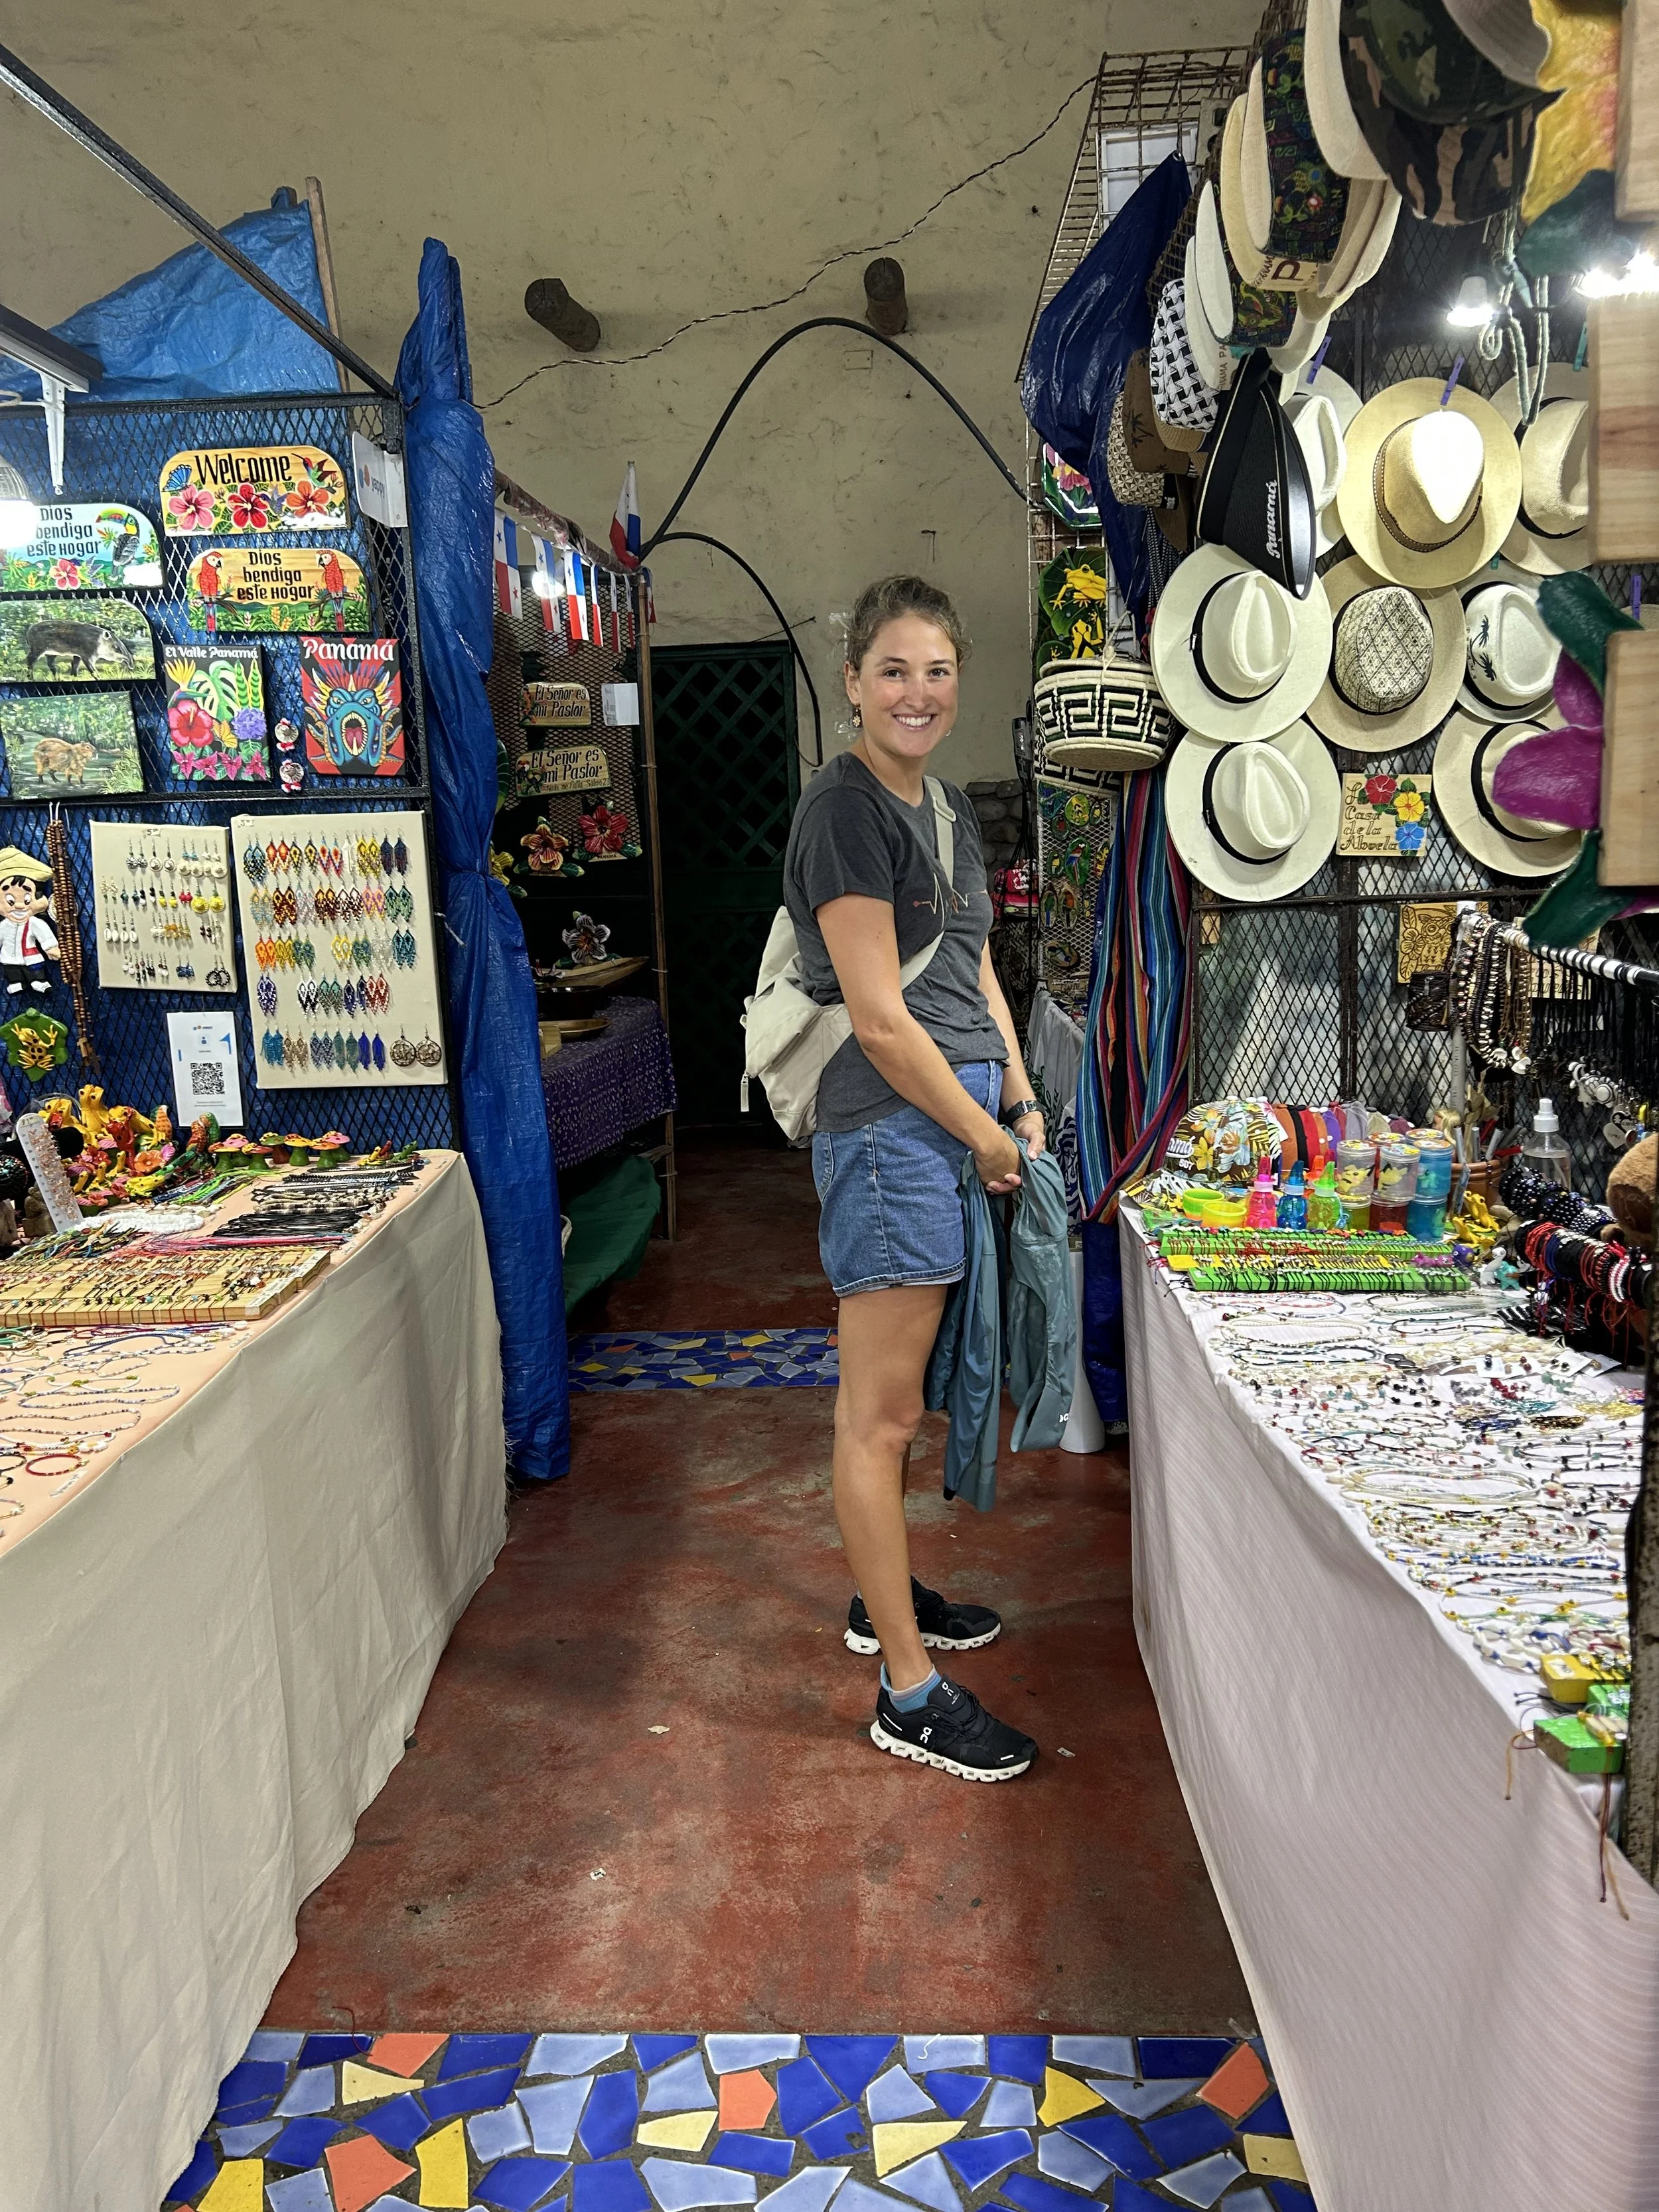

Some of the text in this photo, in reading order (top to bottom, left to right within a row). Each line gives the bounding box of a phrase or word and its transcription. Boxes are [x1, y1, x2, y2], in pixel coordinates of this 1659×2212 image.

[194, 453, 292, 485] Welcome
[1265, 479, 1281, 559] Panamá
[36, 522, 93, 540] bendiga
[27, 540, 56, 557] este
[242, 565, 302, 586] bendiga
[237, 583, 268, 601] este
[165, 646, 259, 659] El Valle Panamá
[303, 638, 395, 662] Panamá
[535, 684, 587, 701] El Señor es
[536, 700, 586, 717] mi Pastor
[532, 749, 599, 769] El Señor es
[544, 761, 603, 783] mi Pastor
[1344, 805, 1382, 820] Casa
[1179, 1158, 1194, 1171] 507
